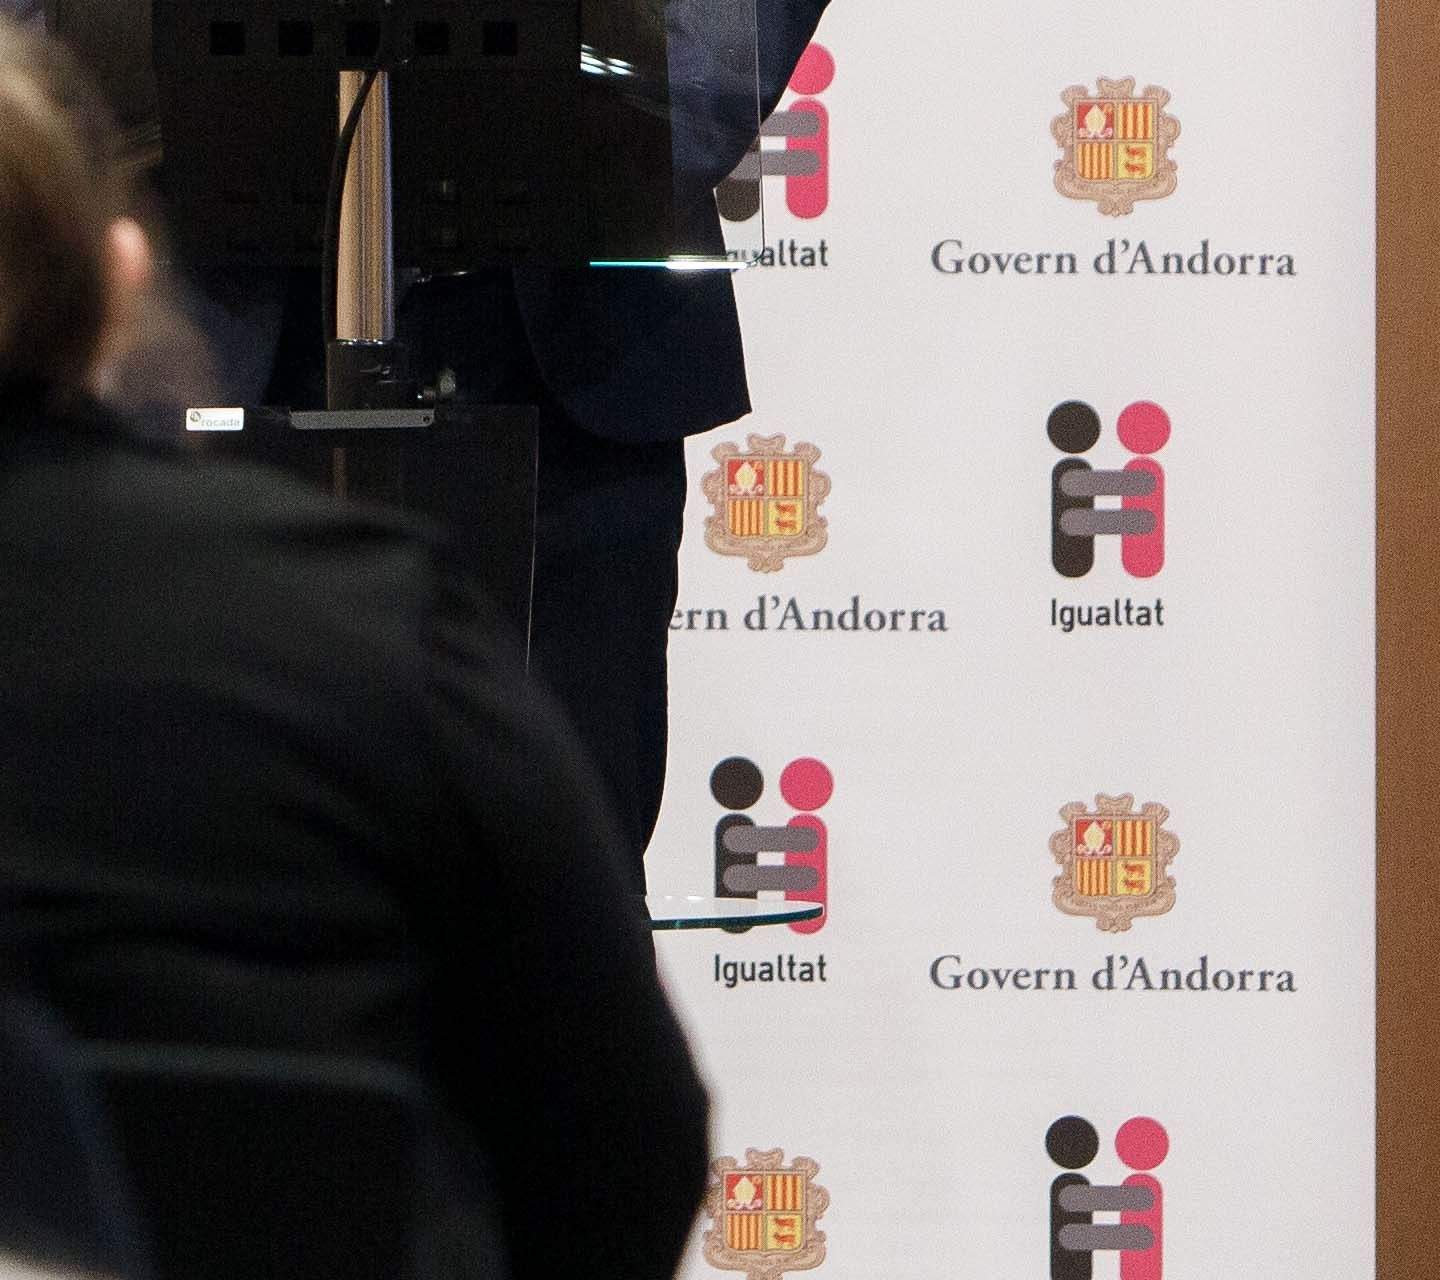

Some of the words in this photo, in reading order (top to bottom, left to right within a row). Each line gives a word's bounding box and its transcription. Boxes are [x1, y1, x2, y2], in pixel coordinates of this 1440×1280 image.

[930, 239, 1078, 276] Govern
[1092, 238, 1297, 277] d'Andorra
[742, 594, 949, 633] d'Andorra
[1050, 597, 1165, 634] Igualtat
[713, 953, 828, 990] Igualtat
[928, 955, 1077, 991] Govern
[1090, 954, 1297, 993] d'Andorra
